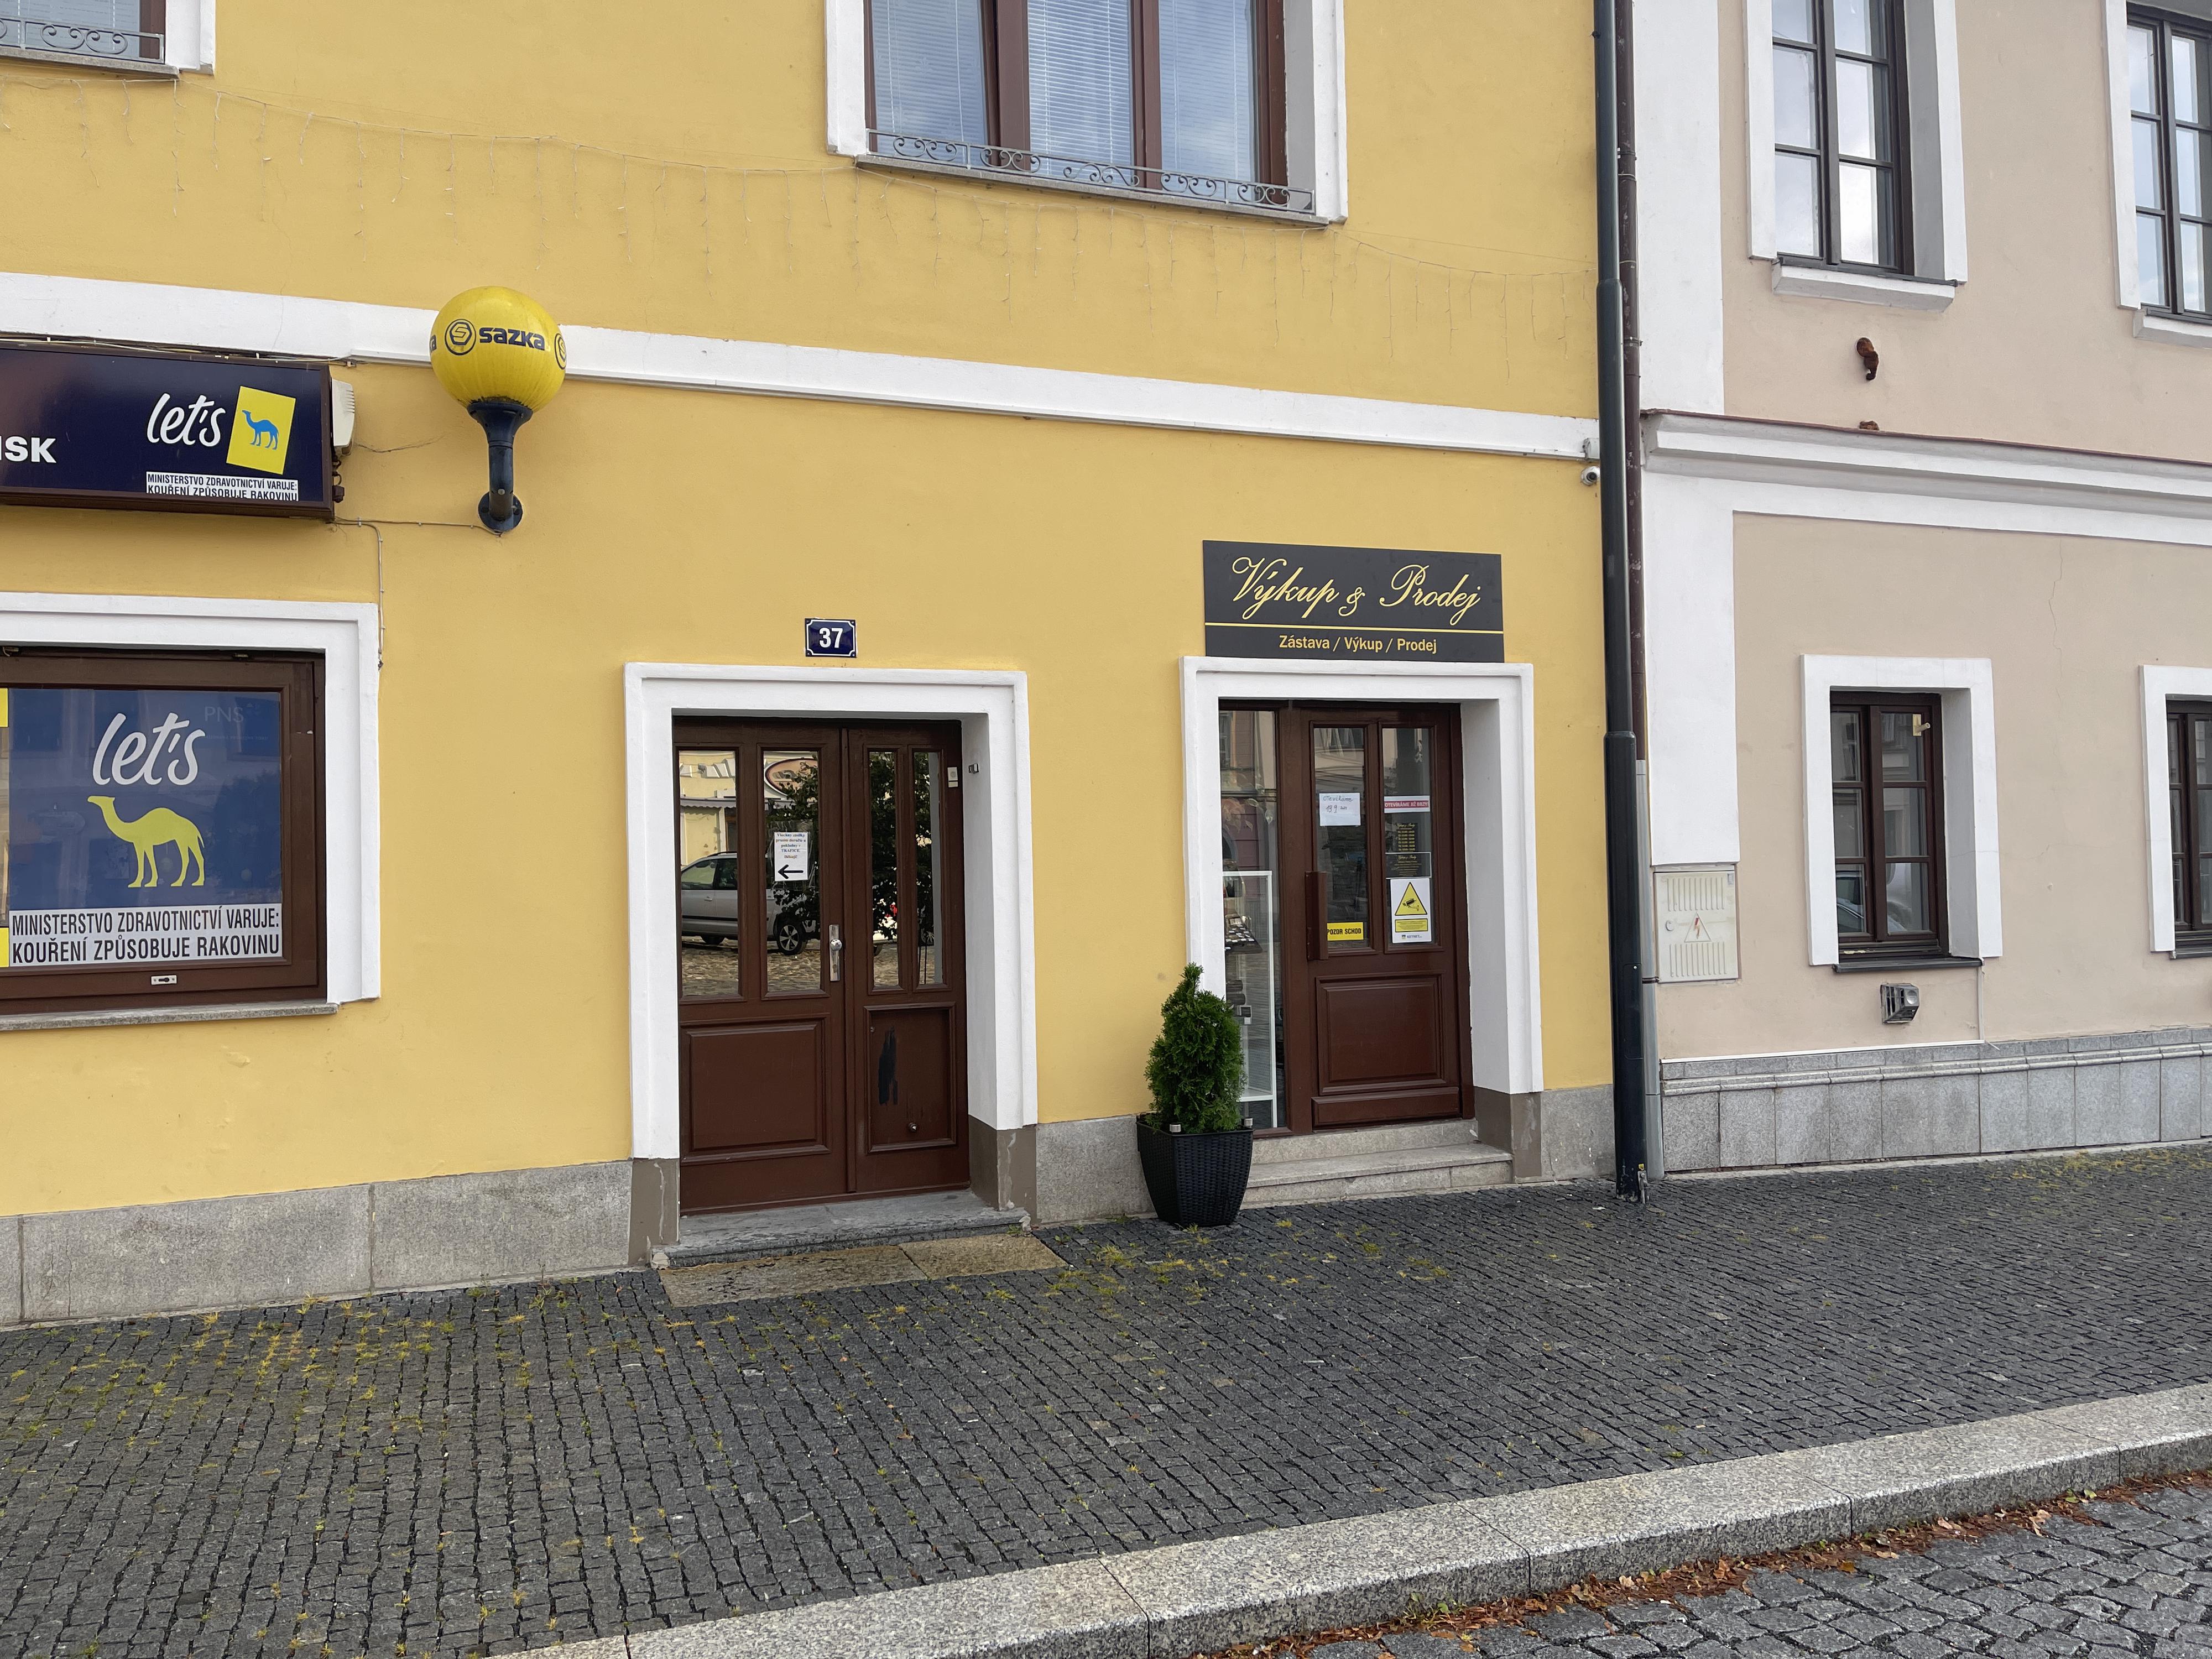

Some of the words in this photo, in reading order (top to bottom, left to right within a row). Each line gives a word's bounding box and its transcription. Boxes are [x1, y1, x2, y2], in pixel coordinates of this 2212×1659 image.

[147, 393, 226, 447] let's
[0, 435, 56, 463] SK
[148, 473, 204, 486] MINISTERSTVO
[206, 477, 264, 489] ZDRAVOTNICTVÍ
[267, 480, 298, 491] VARUJE:
[148, 484, 190, 495] KOUŘENÍ
[194, 486, 247, 498] ZPŮSOBUJE
[251, 490, 297, 501] RAKOVINU
[1232, 556, 1339, 619] Výkup
[1338, 587, 1365, 617] &
[1379, 564, 1481, 626] Prodej
[819, 627, 843, 648] 37
[1279, 635, 1330, 649] Zástava
[1344, 637, 1383, 653] Výkup
[1397, 639, 1437, 654] Prodej
[205, 706, 244, 723] PNS
[92, 712, 206, 785] let's
[12, 912, 113, 936] MINISTERSTVO
[118, 905, 222, 932] ZDRAVOTNICTVÍ
[226, 907, 279, 929] VARUJE:
[13, 936, 88, 964] KOUŘENÍ
[93, 935, 190, 961] ZPŮSOBUJE
[197, 933, 279, 957] RAKOVINU
